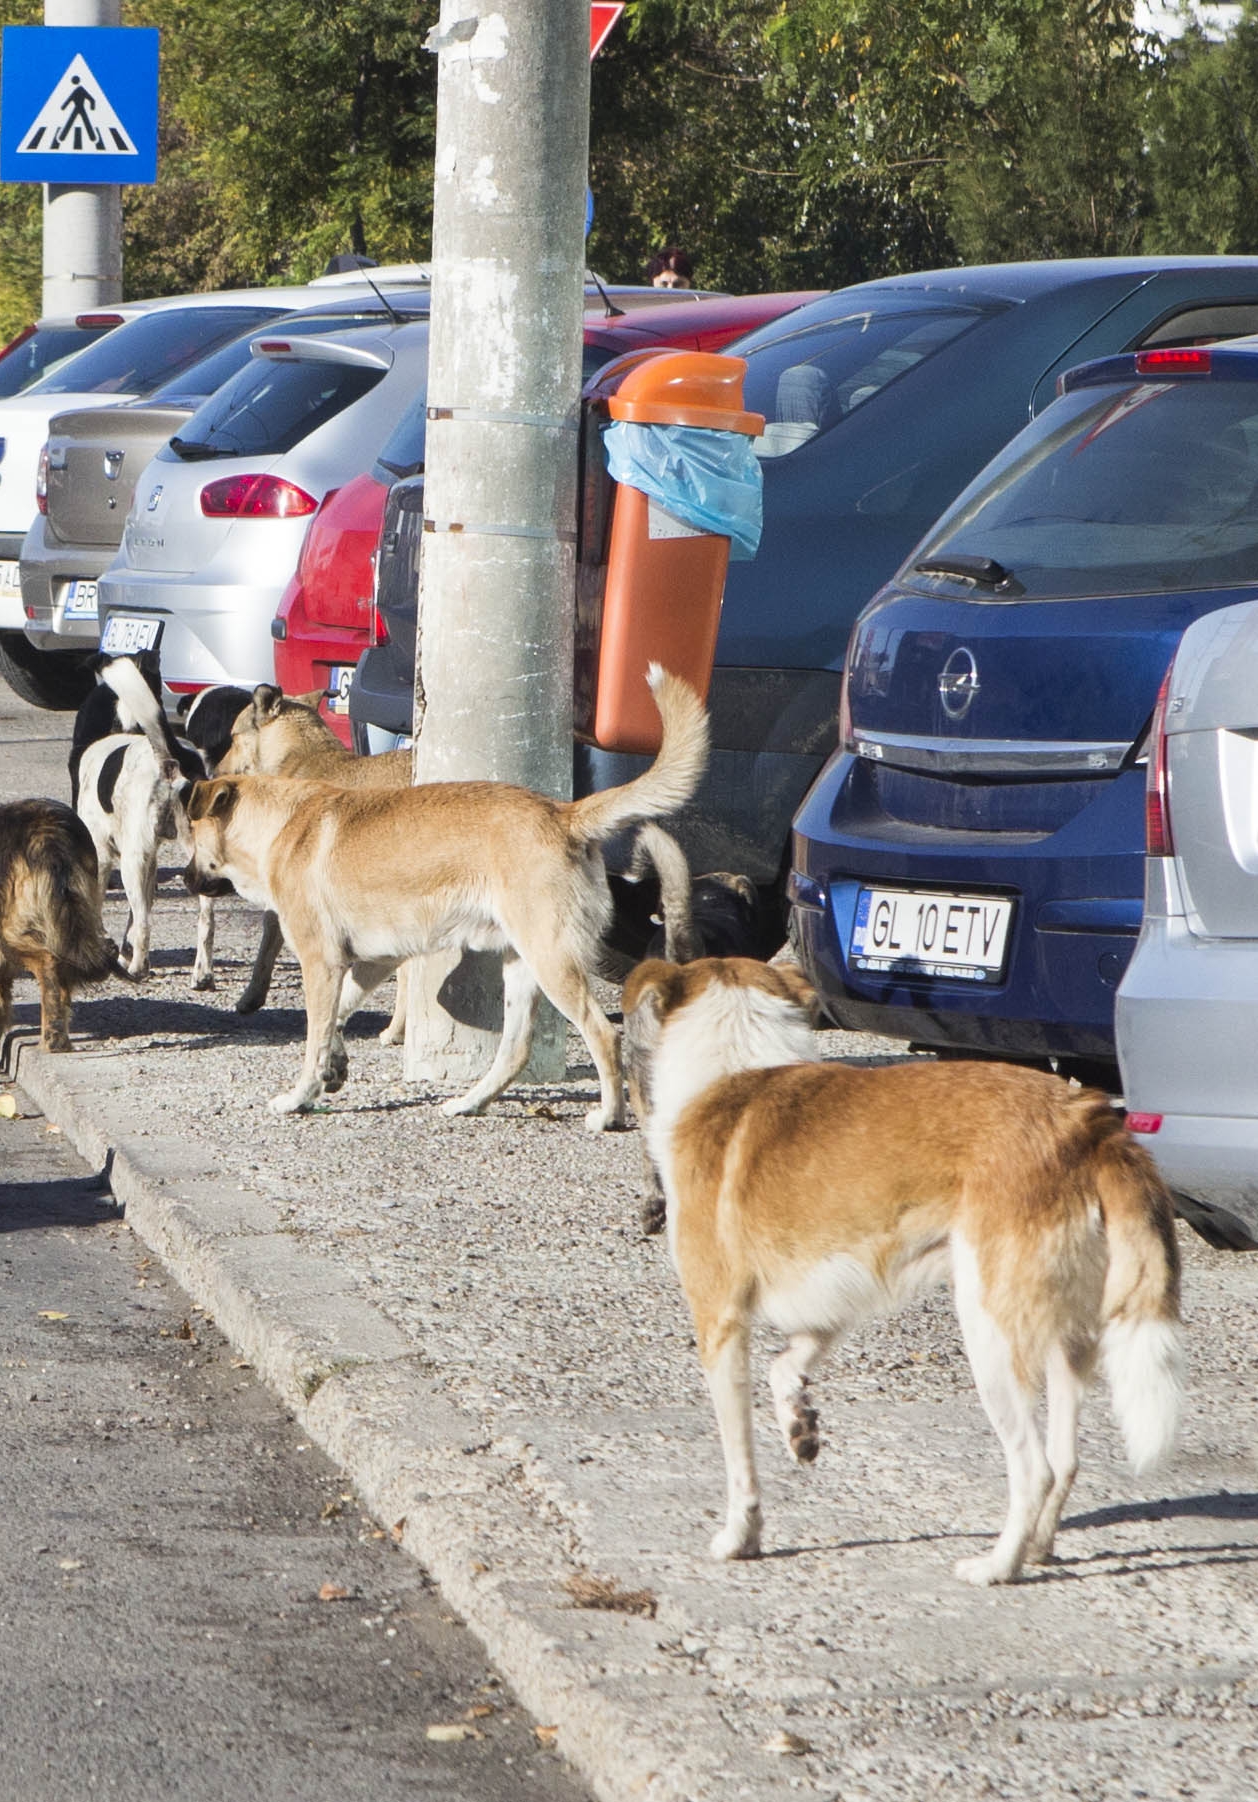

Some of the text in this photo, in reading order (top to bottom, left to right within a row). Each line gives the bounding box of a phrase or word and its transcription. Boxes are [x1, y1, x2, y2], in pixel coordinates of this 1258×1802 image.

[75, 584, 97, 608] BR
[872, 899, 901, 949] GL
[915, 903, 940, 952] 10
[942, 905, 1001, 957] ETV
